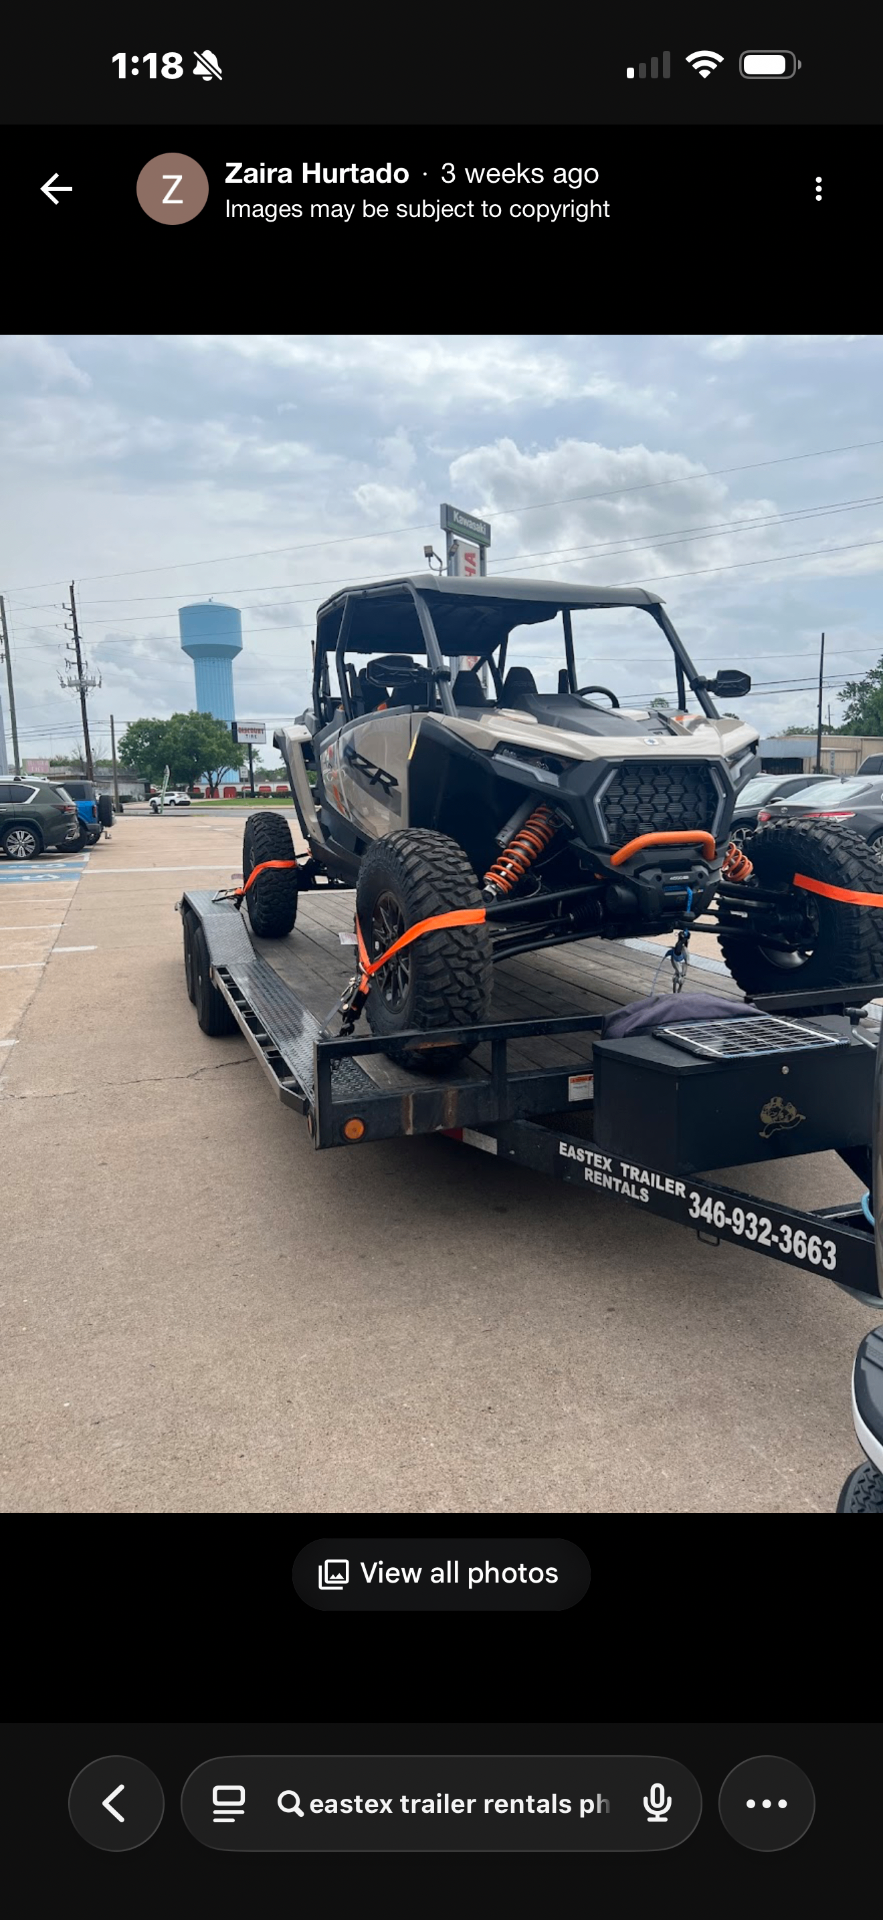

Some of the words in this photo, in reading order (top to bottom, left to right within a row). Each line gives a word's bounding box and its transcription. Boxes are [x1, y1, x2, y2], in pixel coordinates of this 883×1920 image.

[453, 510, 487, 536] Kawasaki
[559, 1141, 612, 1172] EASTEX
[620, 1162, 686, 1199] TRAILER
[584, 1167, 649, 1203] RENTALS
[688, 1191, 837, 1271] 346-932-3663
